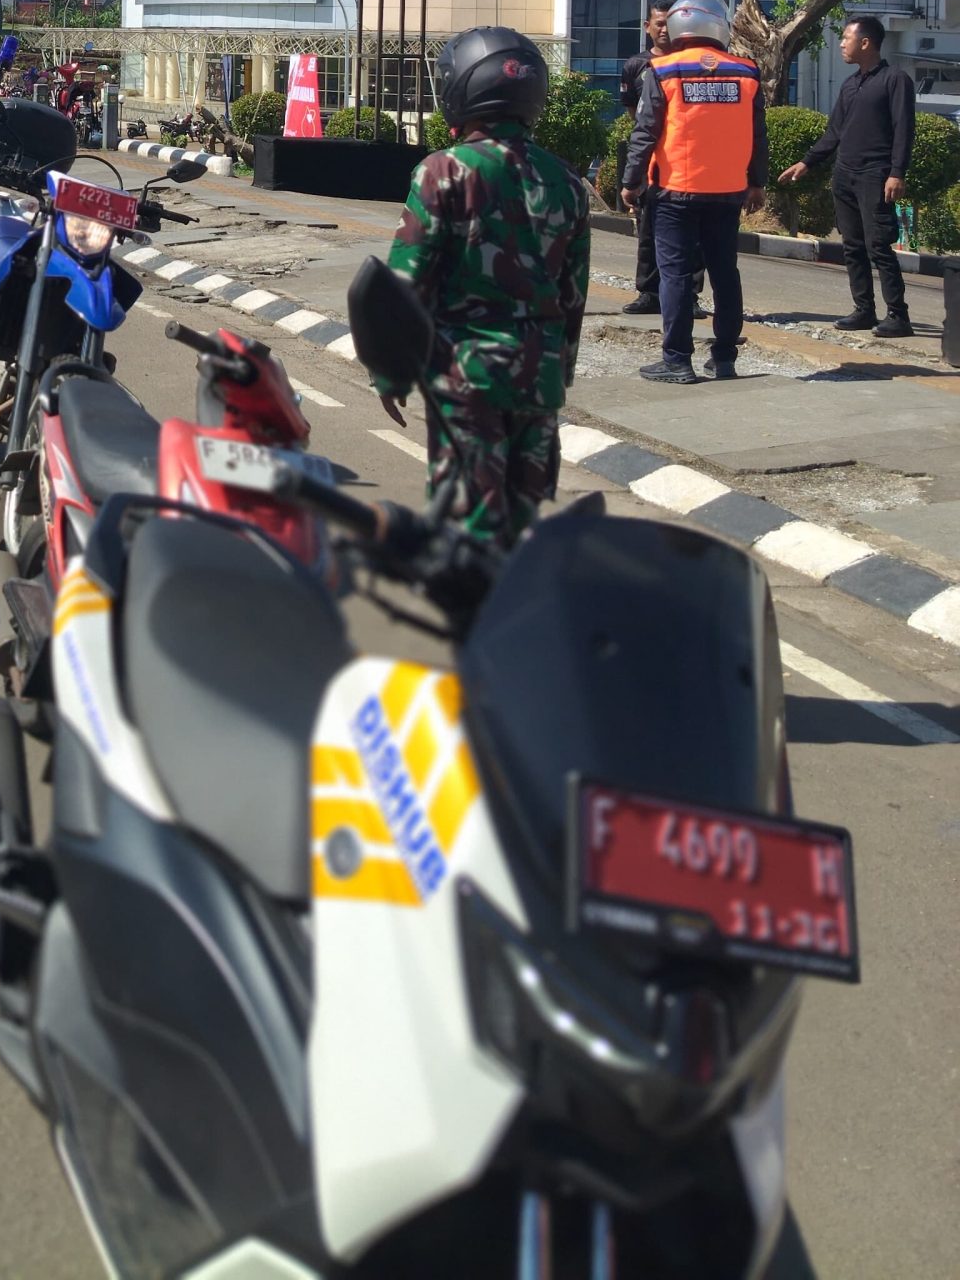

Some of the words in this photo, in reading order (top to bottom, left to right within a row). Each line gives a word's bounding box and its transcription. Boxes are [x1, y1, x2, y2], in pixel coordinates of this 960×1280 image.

[683, 82, 739, 97] DISHUB
[61, 179, 70, 193] F
[79, 186, 111, 207] 4273
[126, 199, 136, 214] H
[354, 693, 448, 898] DISHUB
[592, 796, 618, 851] F
[655, 812, 760, 881] 4699
[809, 844, 844, 896] H
